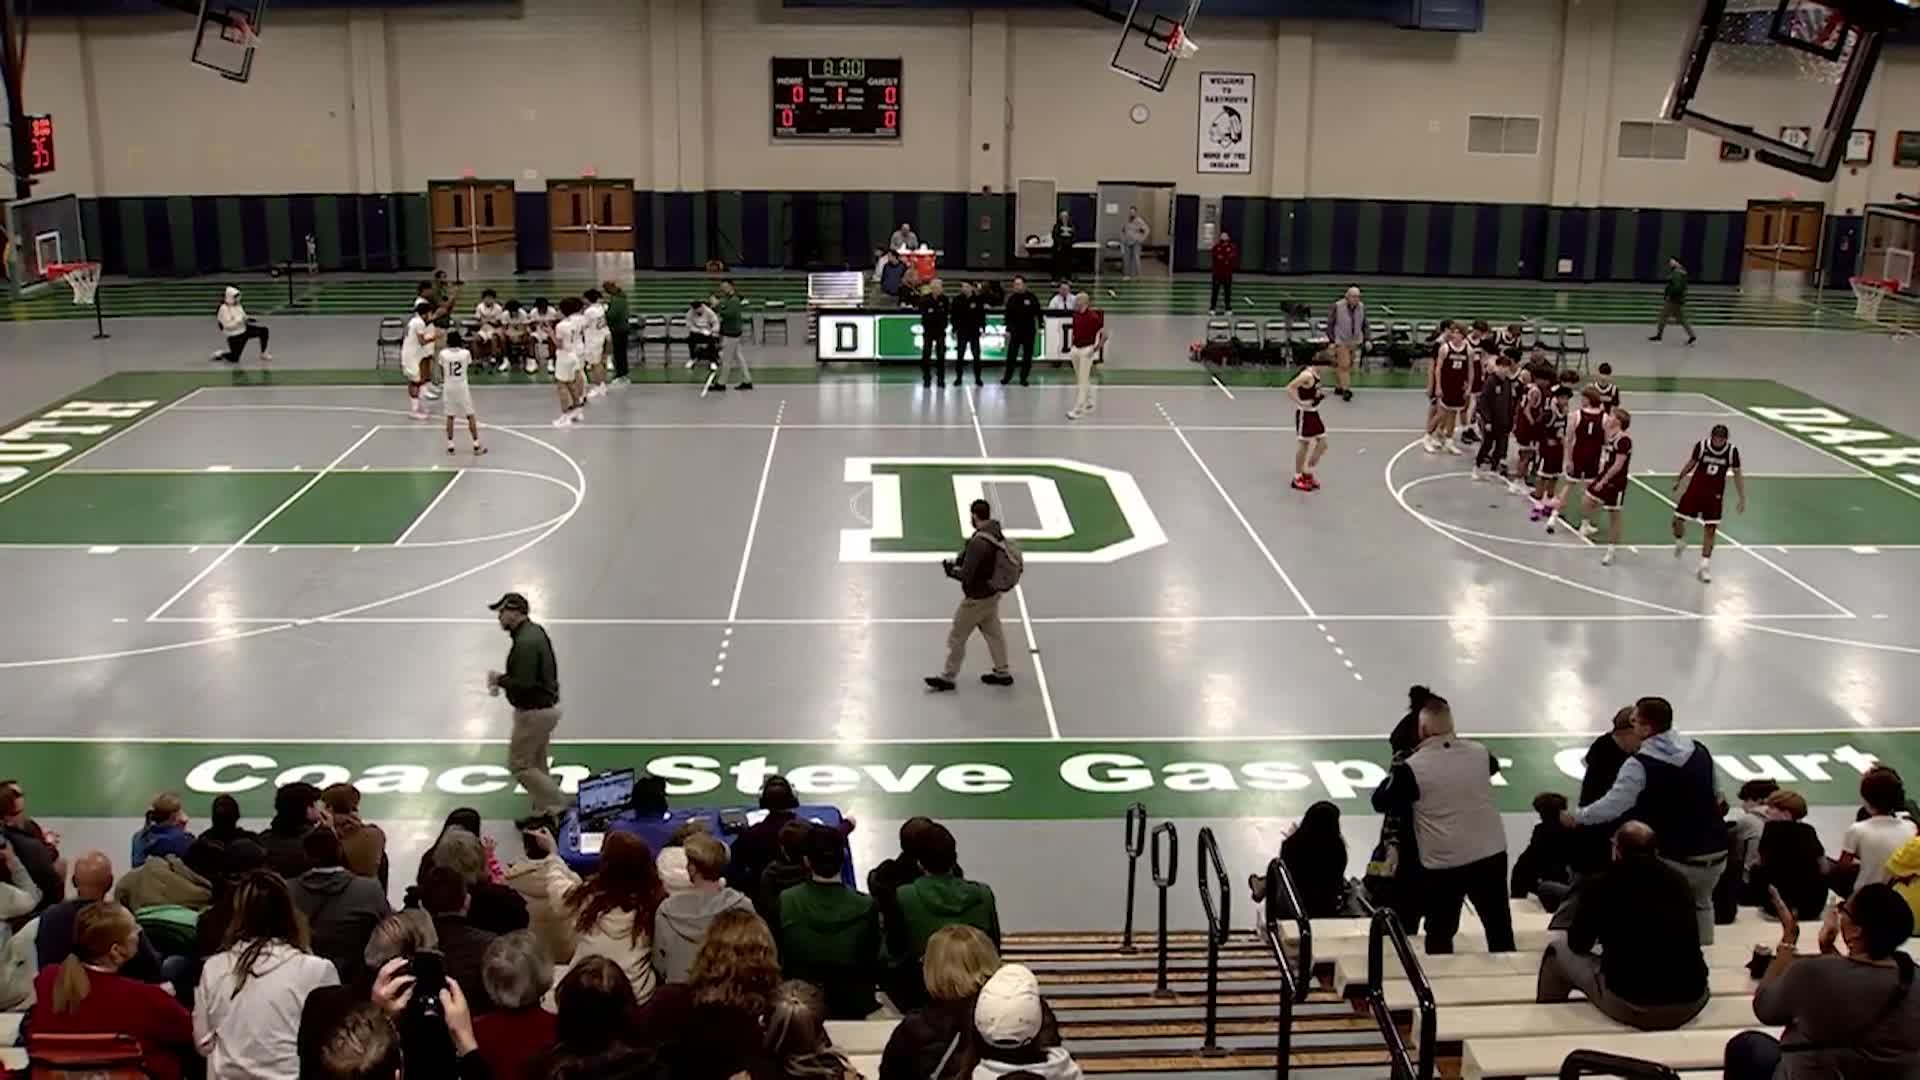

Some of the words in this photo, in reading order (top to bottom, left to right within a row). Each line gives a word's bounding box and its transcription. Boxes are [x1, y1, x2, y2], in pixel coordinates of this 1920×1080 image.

[793, 86, 803, 103] 0
[884, 86, 896, 104] 0
[782, 109, 793, 127] 0
[885, 110, 896, 127] 0
[31, 137, 50, 168] 35
[835, 322, 858, 352] D
[449, 361, 462, 377] 12
[1746, 406, 1920, 485] DAR
[840, 457, 1168, 562] D
[646, 755, 1014, 794] Steve
